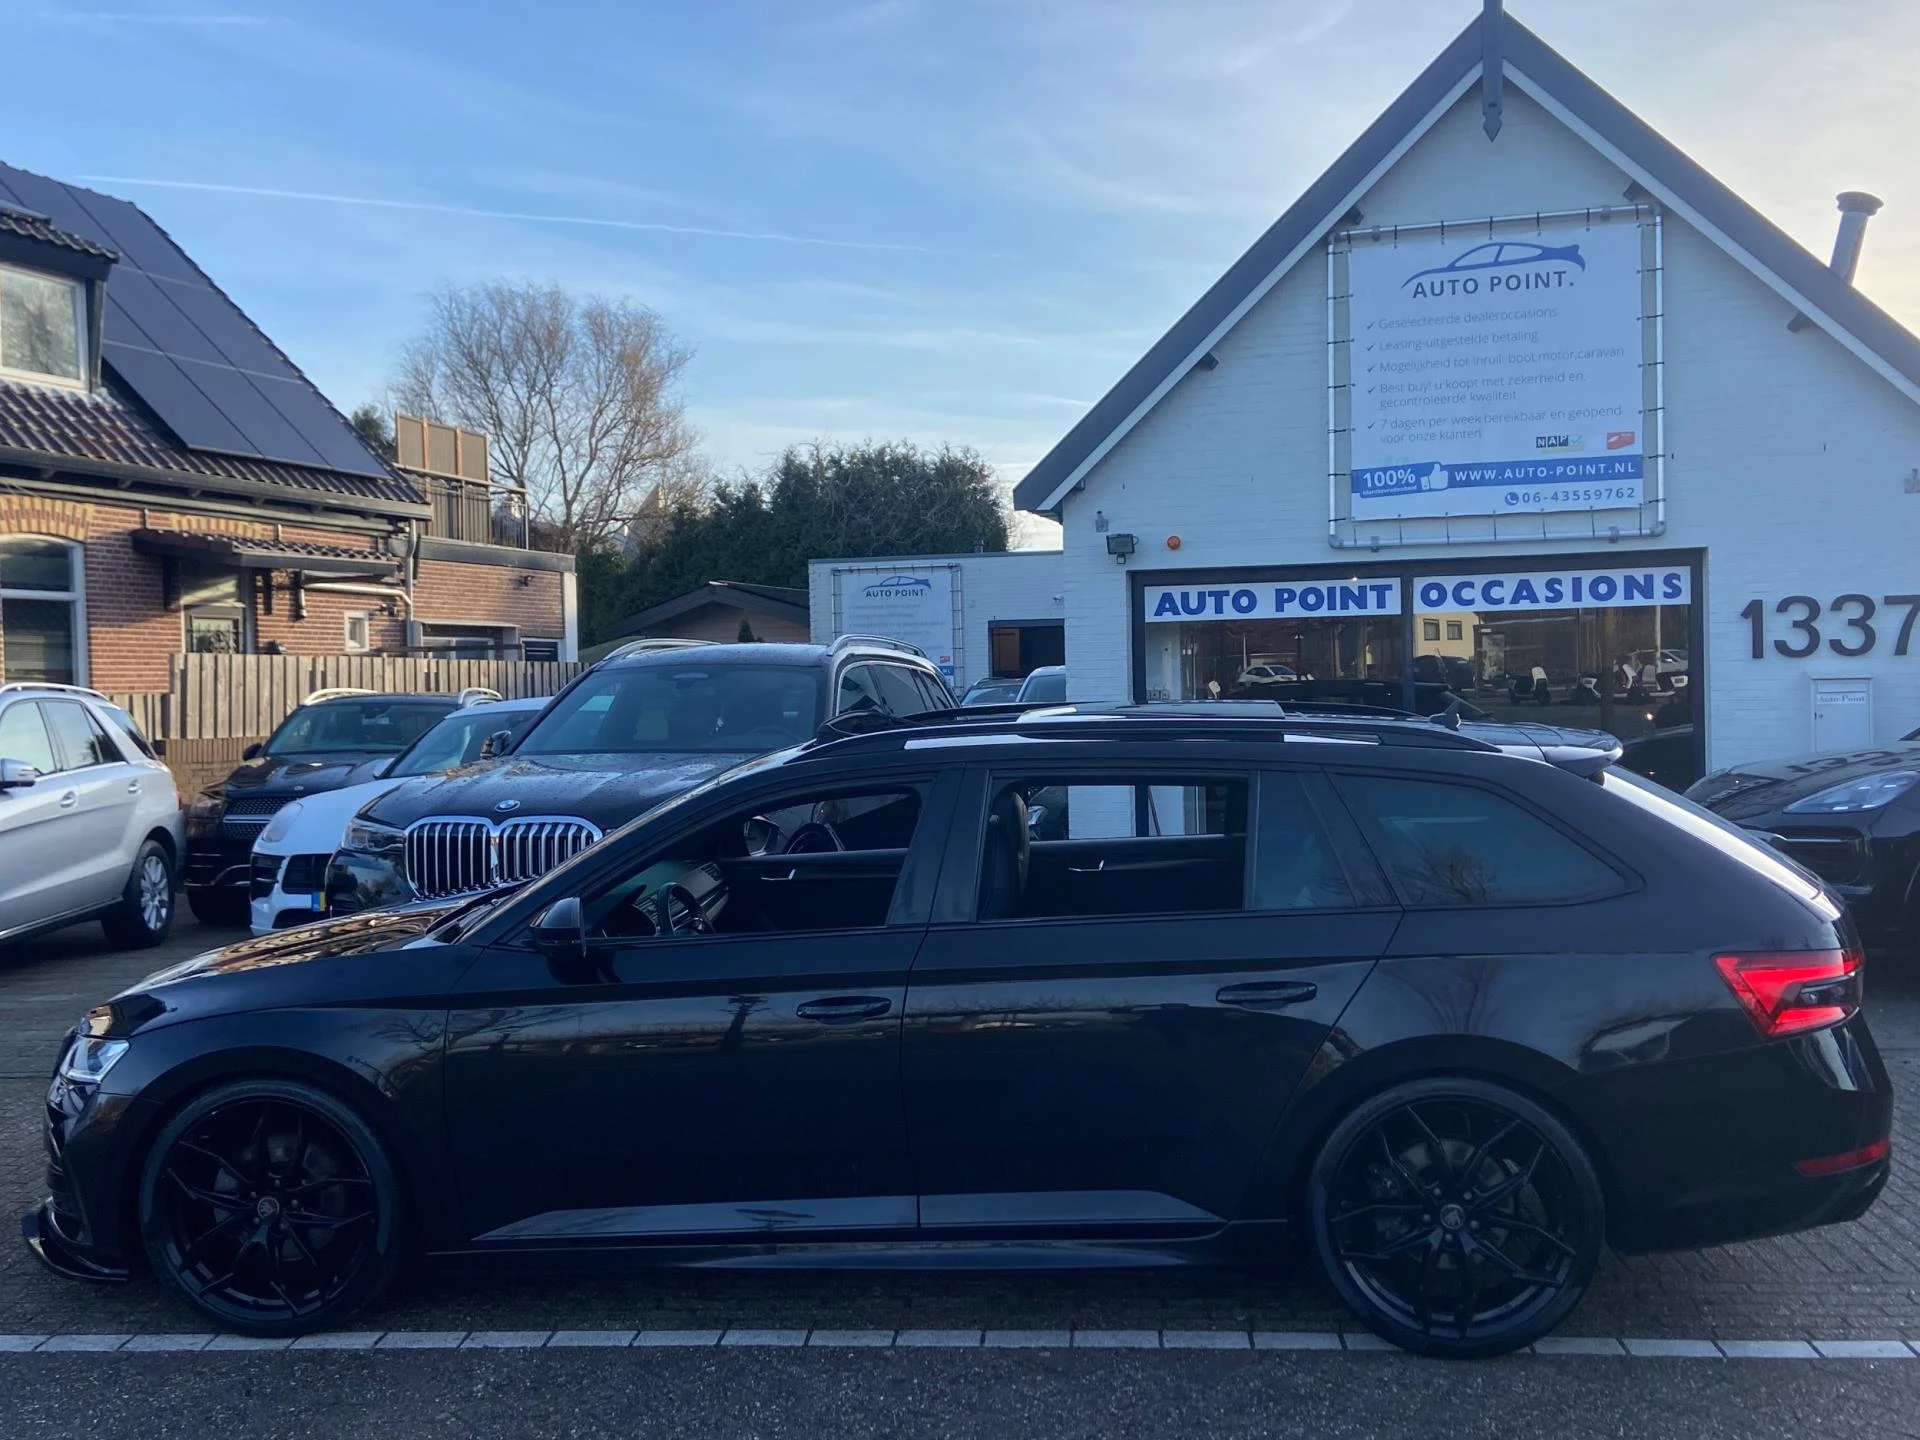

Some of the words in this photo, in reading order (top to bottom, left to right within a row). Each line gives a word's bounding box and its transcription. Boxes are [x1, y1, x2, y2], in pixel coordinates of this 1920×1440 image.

[1412, 278, 1478, 299] AUTO
[1379, 313, 1461, 330] Geselecteerde
[1464, 307, 1558, 324] dealeroccasions
[1492, 330, 1539, 343] betaling
[1379, 356, 1450, 373] Mogelijkheid
[1453, 357, 1469, 368] tot
[1380, 382, 1404, 394] Best
[1434, 381, 1442, 390] u
[1446, 377, 1478, 391] koopt
[1482, 376, 1505, 387] met
[1507, 372, 1565, 386] zekerheid
[1379, 392, 1467, 411] gecontroleerde
[1470, 390, 1516, 402] kwaliteit
[1380, 418, 1387, 429] 7
[1390, 417, 1425, 431] dagen
[1429, 417, 1447, 429] per
[1450, 414, 1482, 425] week
[1484, 410, 1546, 424] bereikbaar
[1550, 410, 1565, 420] en
[1568, 404, 1622, 422] geopend
[1380, 434, 1405, 444] voor
[1408, 432, 1436, 443] onze
[1439, 429, 1482, 441] klanten
[1363, 468, 1416, 488] 100%
[1454, 462, 1635, 481] WWW.AUTO-POINT.NL
[1522, 487, 1636, 503] 06-43559762
[865, 590, 892, 598] AUTO
[1153, 589, 1258, 617] AUTO
[1275, 584, 1393, 614] POINT
[1420, 572, 1683, 608] OCCASIONS
[1740, 593, 1920, 659] 1337
